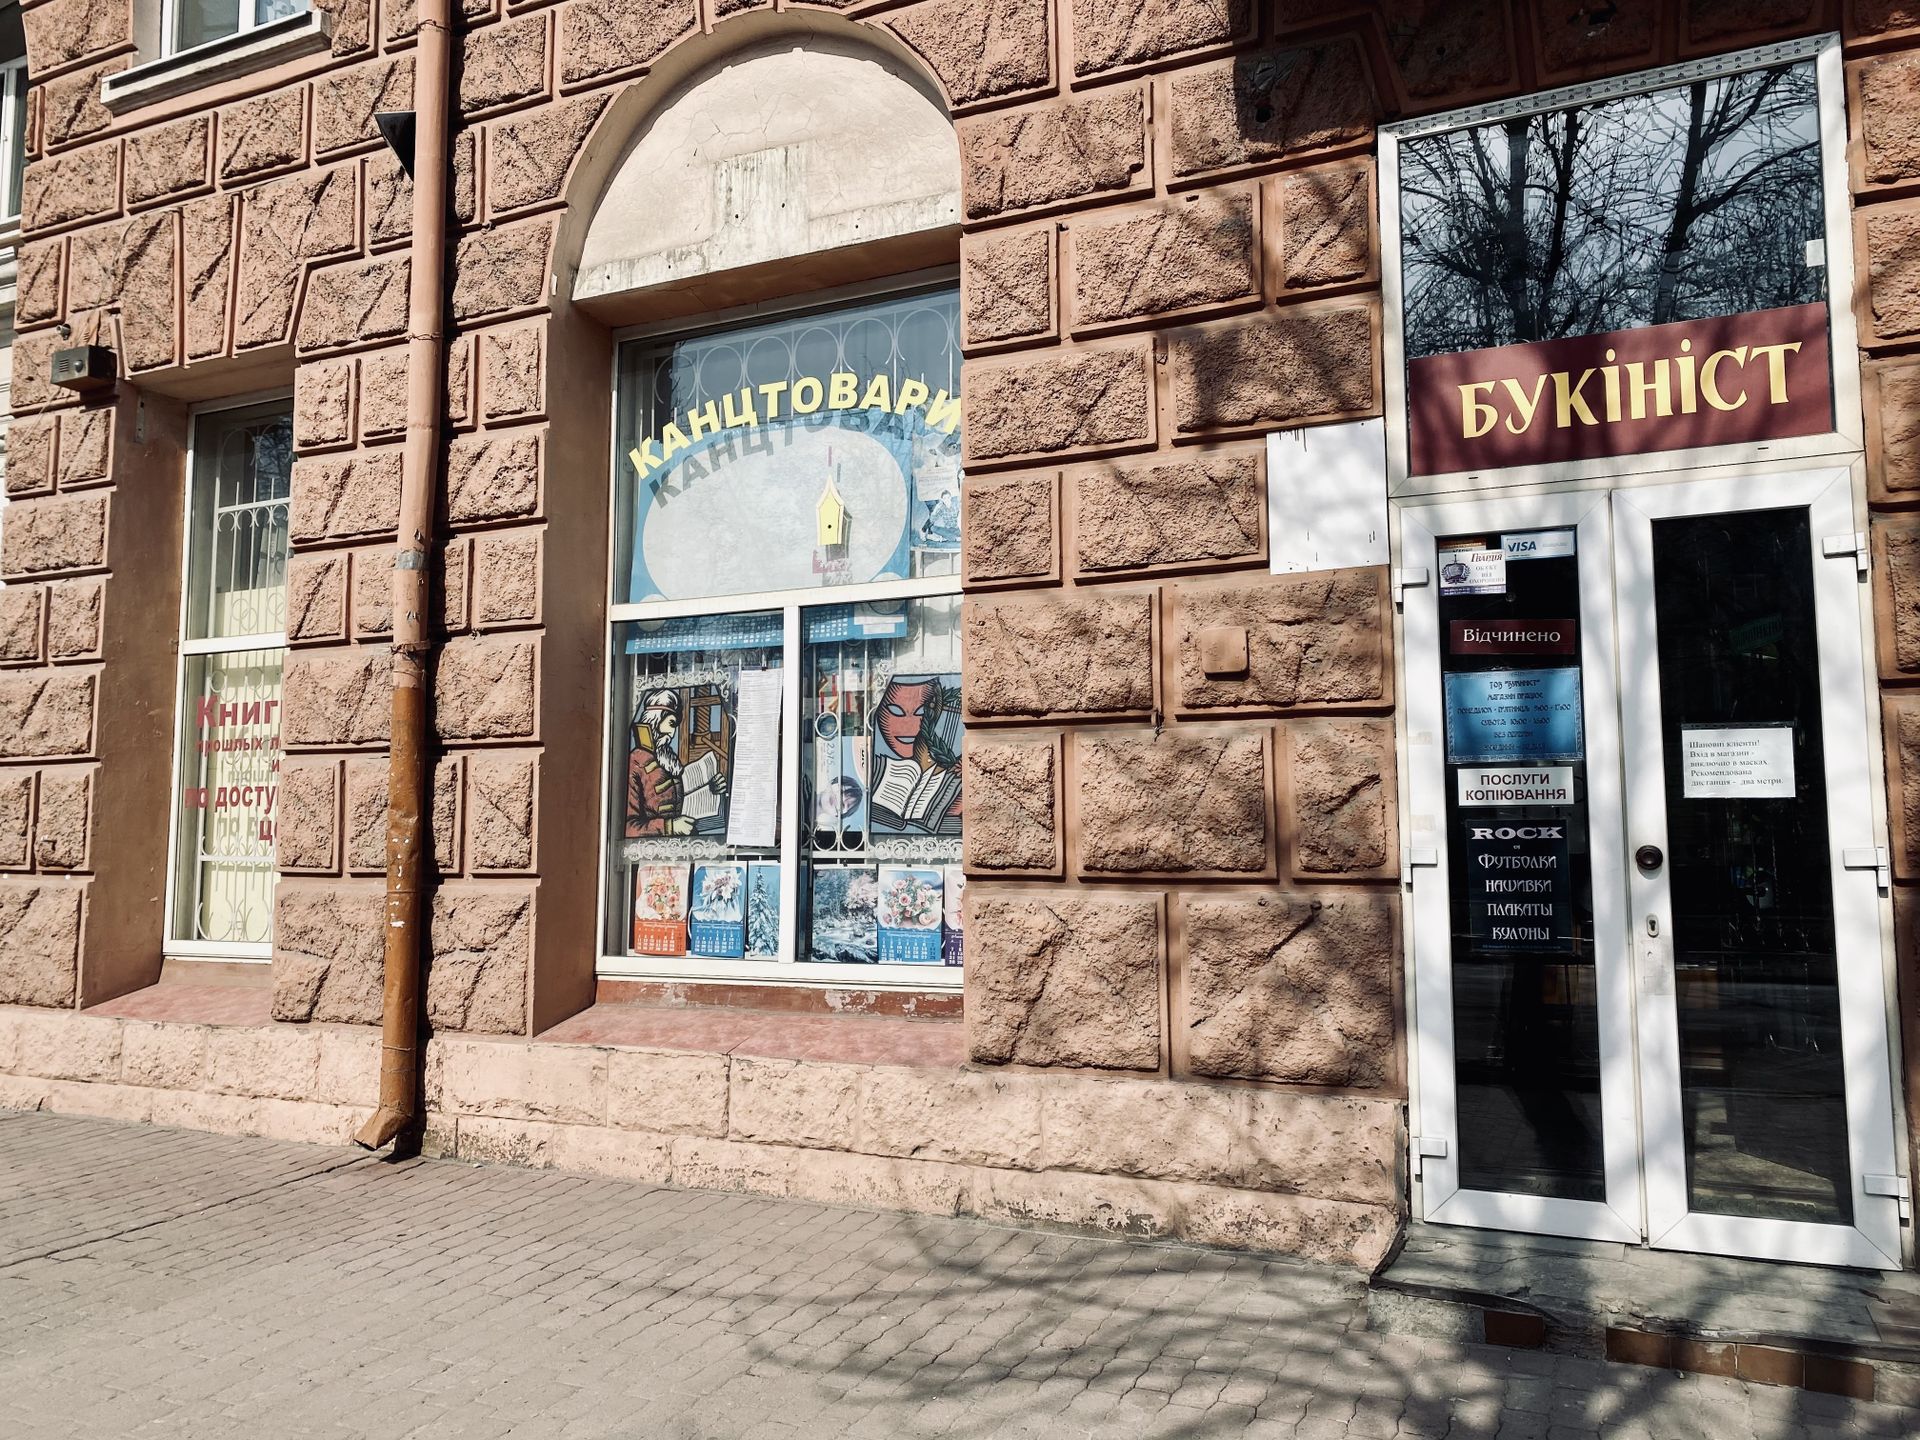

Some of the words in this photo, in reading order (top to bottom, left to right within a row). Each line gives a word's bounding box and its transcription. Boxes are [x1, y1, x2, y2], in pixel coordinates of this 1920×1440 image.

[628, 372, 961, 480] КАНЦТОВАРИ
[1507, 541, 1537, 552] VISA
[1463, 628, 1561, 643] Відчинено
[195, 694, 282, 728] Книг
[1480, 773, 1550, 786] ПОСЛУГИ
[215, 785, 279, 815] досту
[1466, 788, 1566, 801] КОПІЮВАННЯ
[1470, 827, 1564, 840] ROCK
[1485, 879, 1552, 893] НАШИВКИ
[1487, 903, 1553, 917] ПЛАКАТЫ
[1492, 927, 1550, 941] КУЛОНЫ
